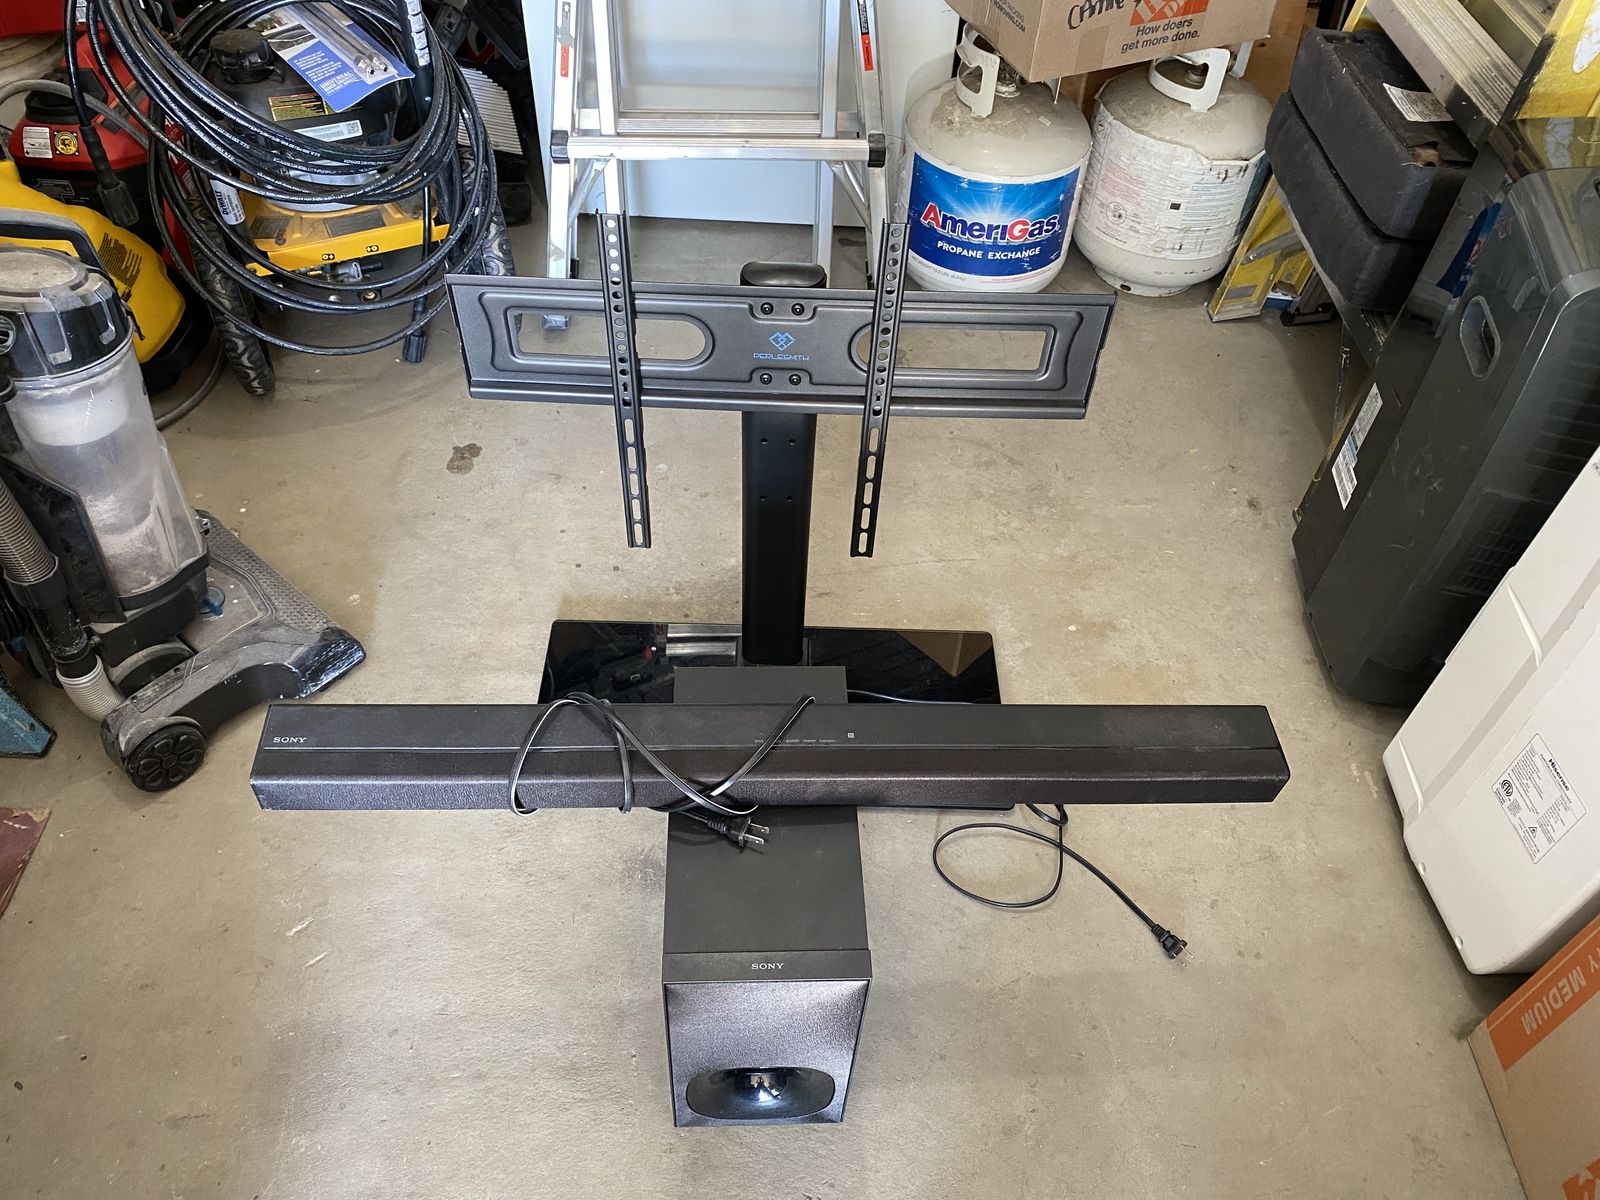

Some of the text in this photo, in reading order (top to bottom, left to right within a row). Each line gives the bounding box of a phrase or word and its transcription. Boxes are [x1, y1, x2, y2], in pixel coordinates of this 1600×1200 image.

[1136, 18, 1193, 37] How doers
[1121, 29, 1201, 54] get more done.
[920, 202, 1060, 242] AmeriGas
[937, 240, 983, 259] PROPANE
[988, 246, 1041, 260] EXCHANGE
[753, 352, 810, 361] PERLESMITH
[1548, 758, 1570, 792] Hisense
[751, 962, 784, 970] SONY
[1521, 965, 1587, 1036] MEDIUM
